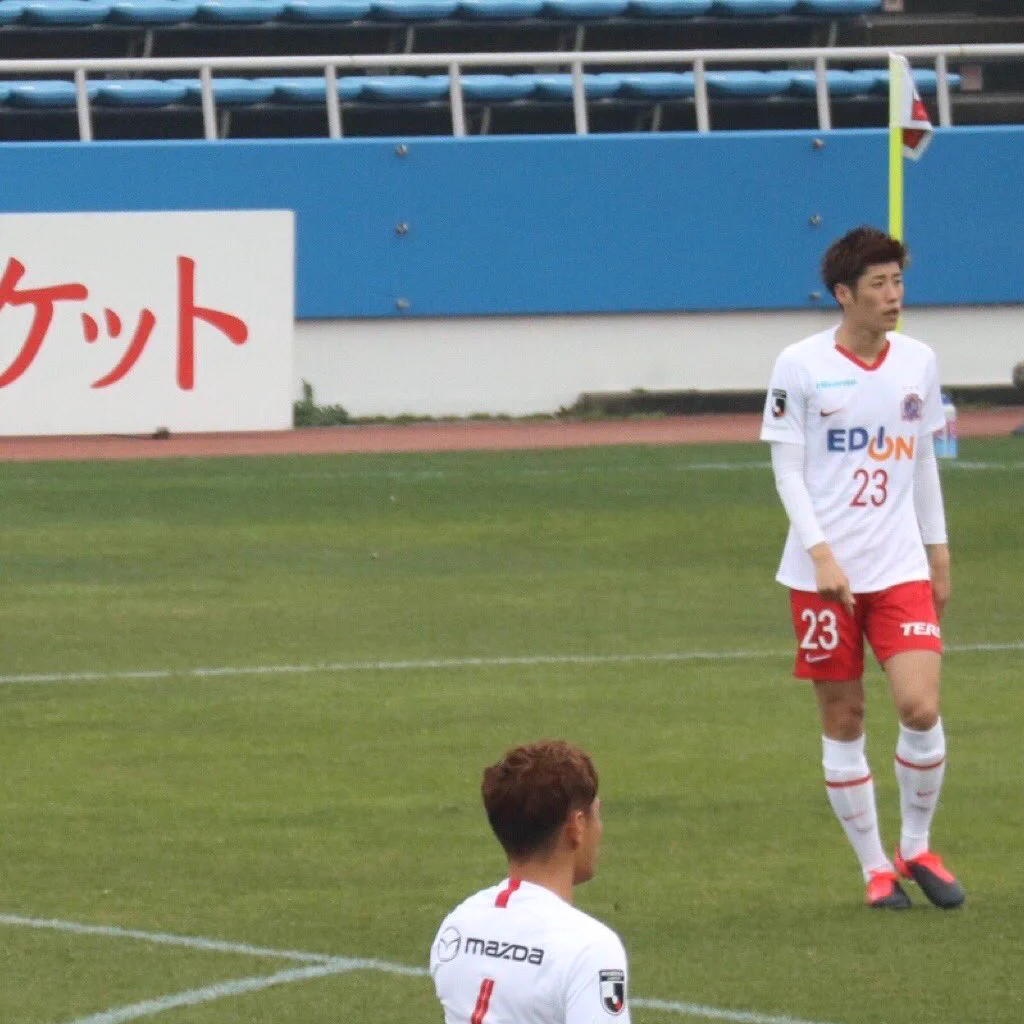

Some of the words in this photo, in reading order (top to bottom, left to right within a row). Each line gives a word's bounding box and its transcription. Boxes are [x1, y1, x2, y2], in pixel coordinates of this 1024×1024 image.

[0, 256, 249, 391] ケット
[827, 425, 915, 462] EDION
[849, 468, 889, 508] 23
[800, 608, 839, 651] 23
[899, 621, 941, 639] TER
